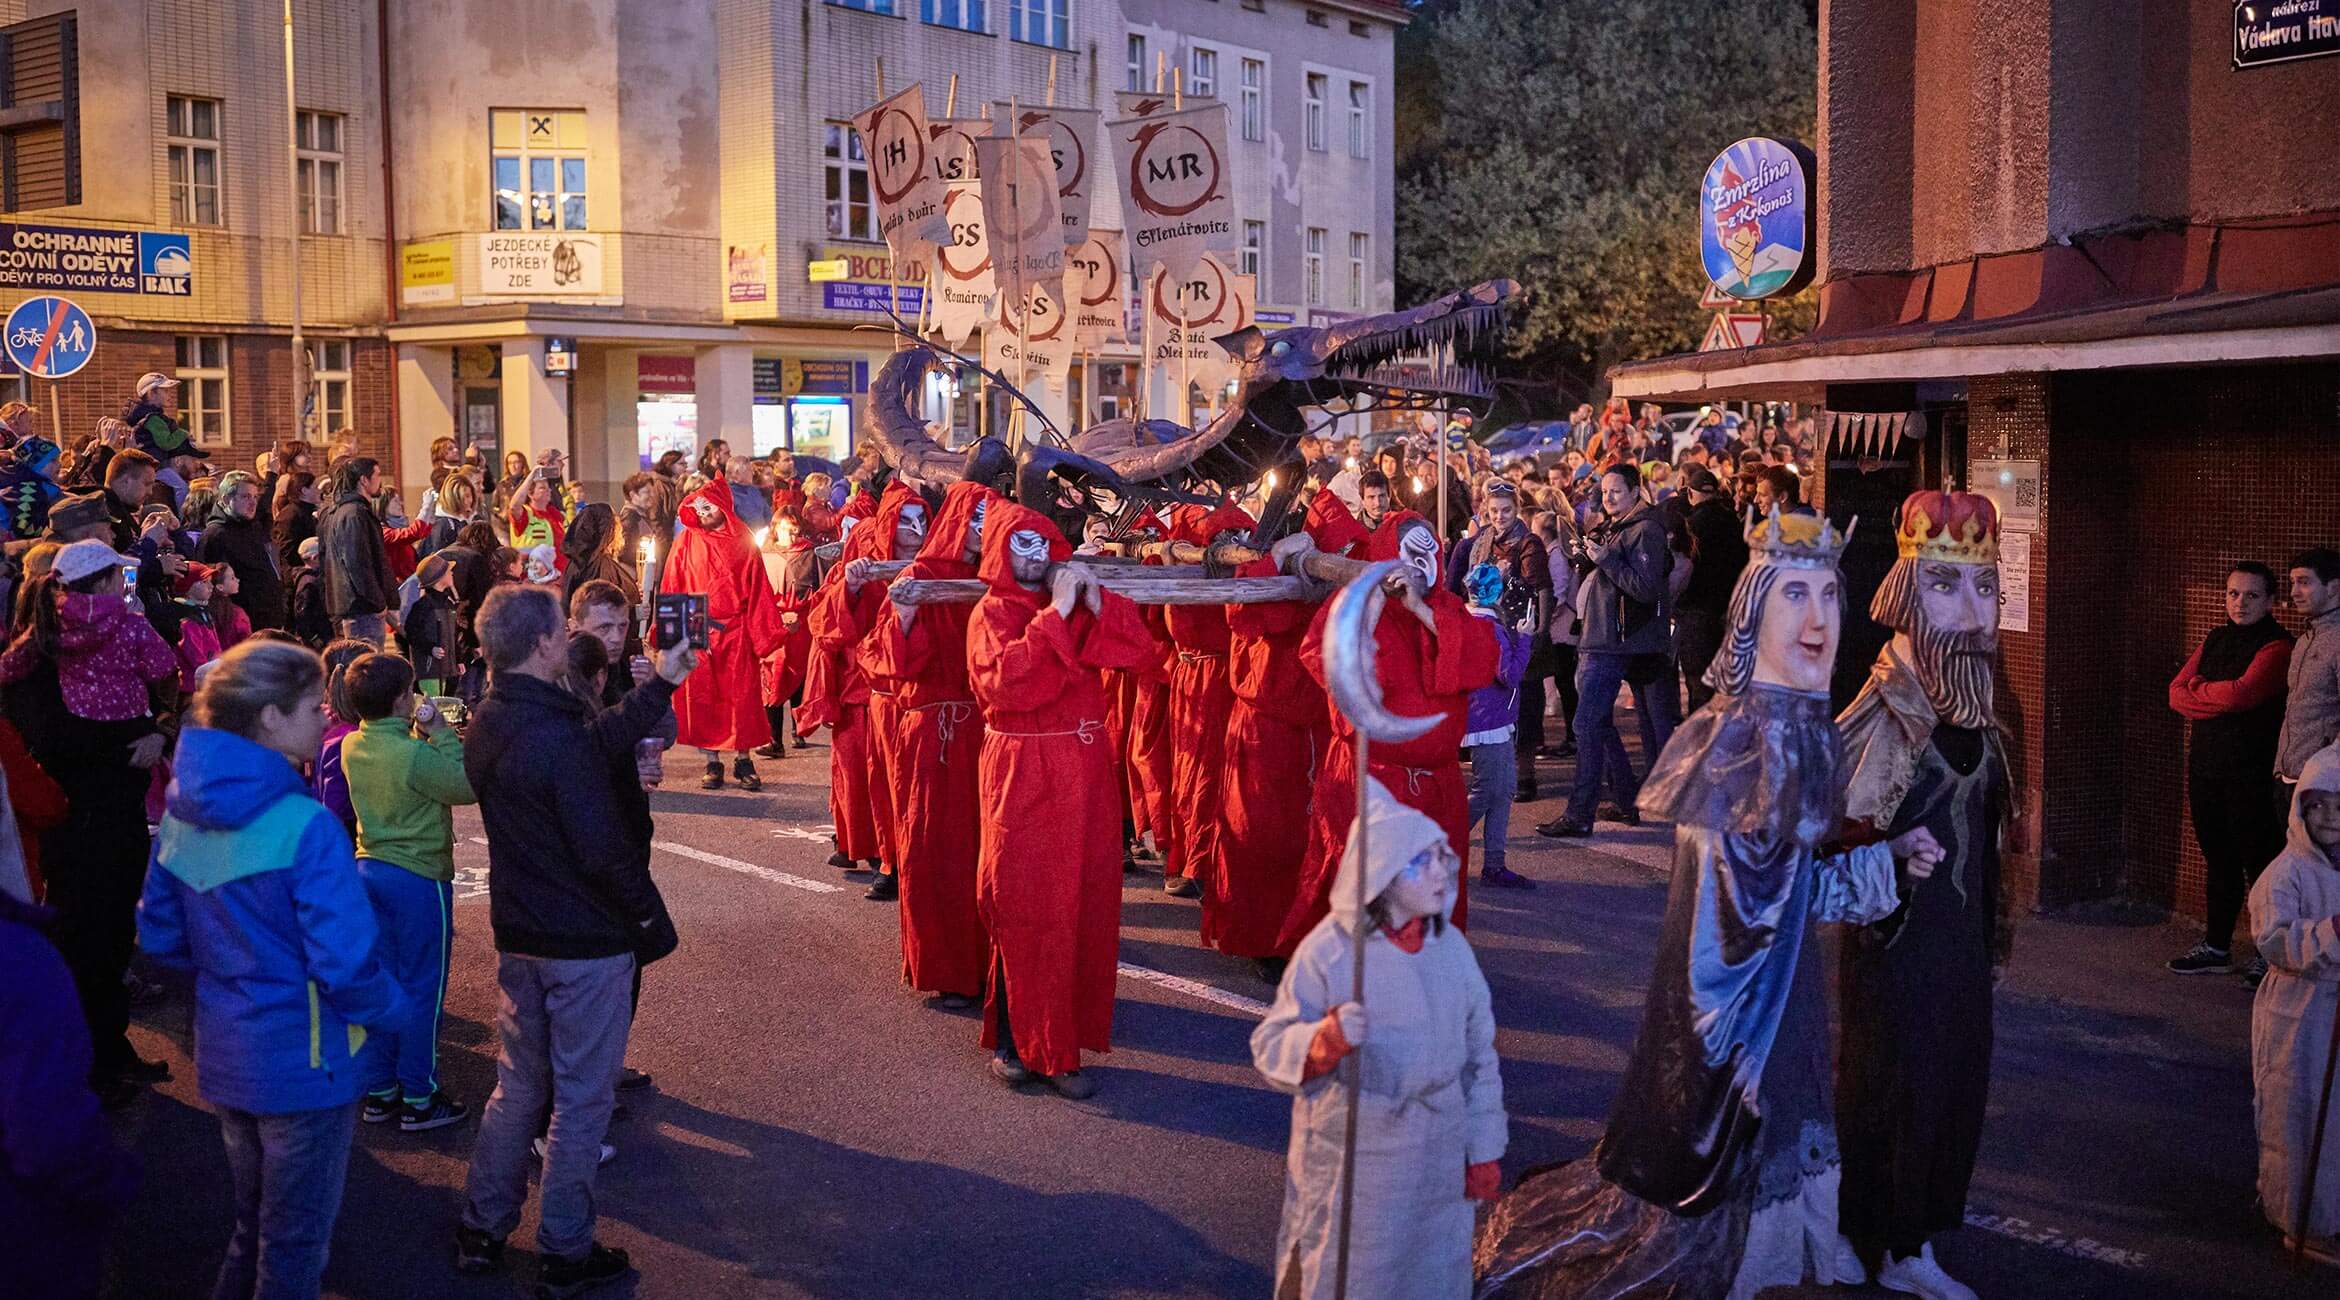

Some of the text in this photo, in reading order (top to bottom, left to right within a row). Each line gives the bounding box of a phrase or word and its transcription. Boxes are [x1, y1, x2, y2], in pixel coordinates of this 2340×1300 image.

[2239, 21, 2301, 51] Václava
[1147, 153, 1204, 184] MR
[1711, 160, 1791, 212] Zmrzlina
[1728, 188, 1793, 229] z Krkonoš
[13, 231, 135, 255] OCHRANNÉ
[487, 235, 552, 252] JEZDECKÉ
[61, 251, 135, 274] ODĚVY
[491, 253, 548, 270] POTŘEBY
[36, 274, 63, 286] PRO
[66, 273, 108, 287] VOLNÝ
[110, 274, 136, 289] ČAS
[508, 274, 532, 288] ZDE
